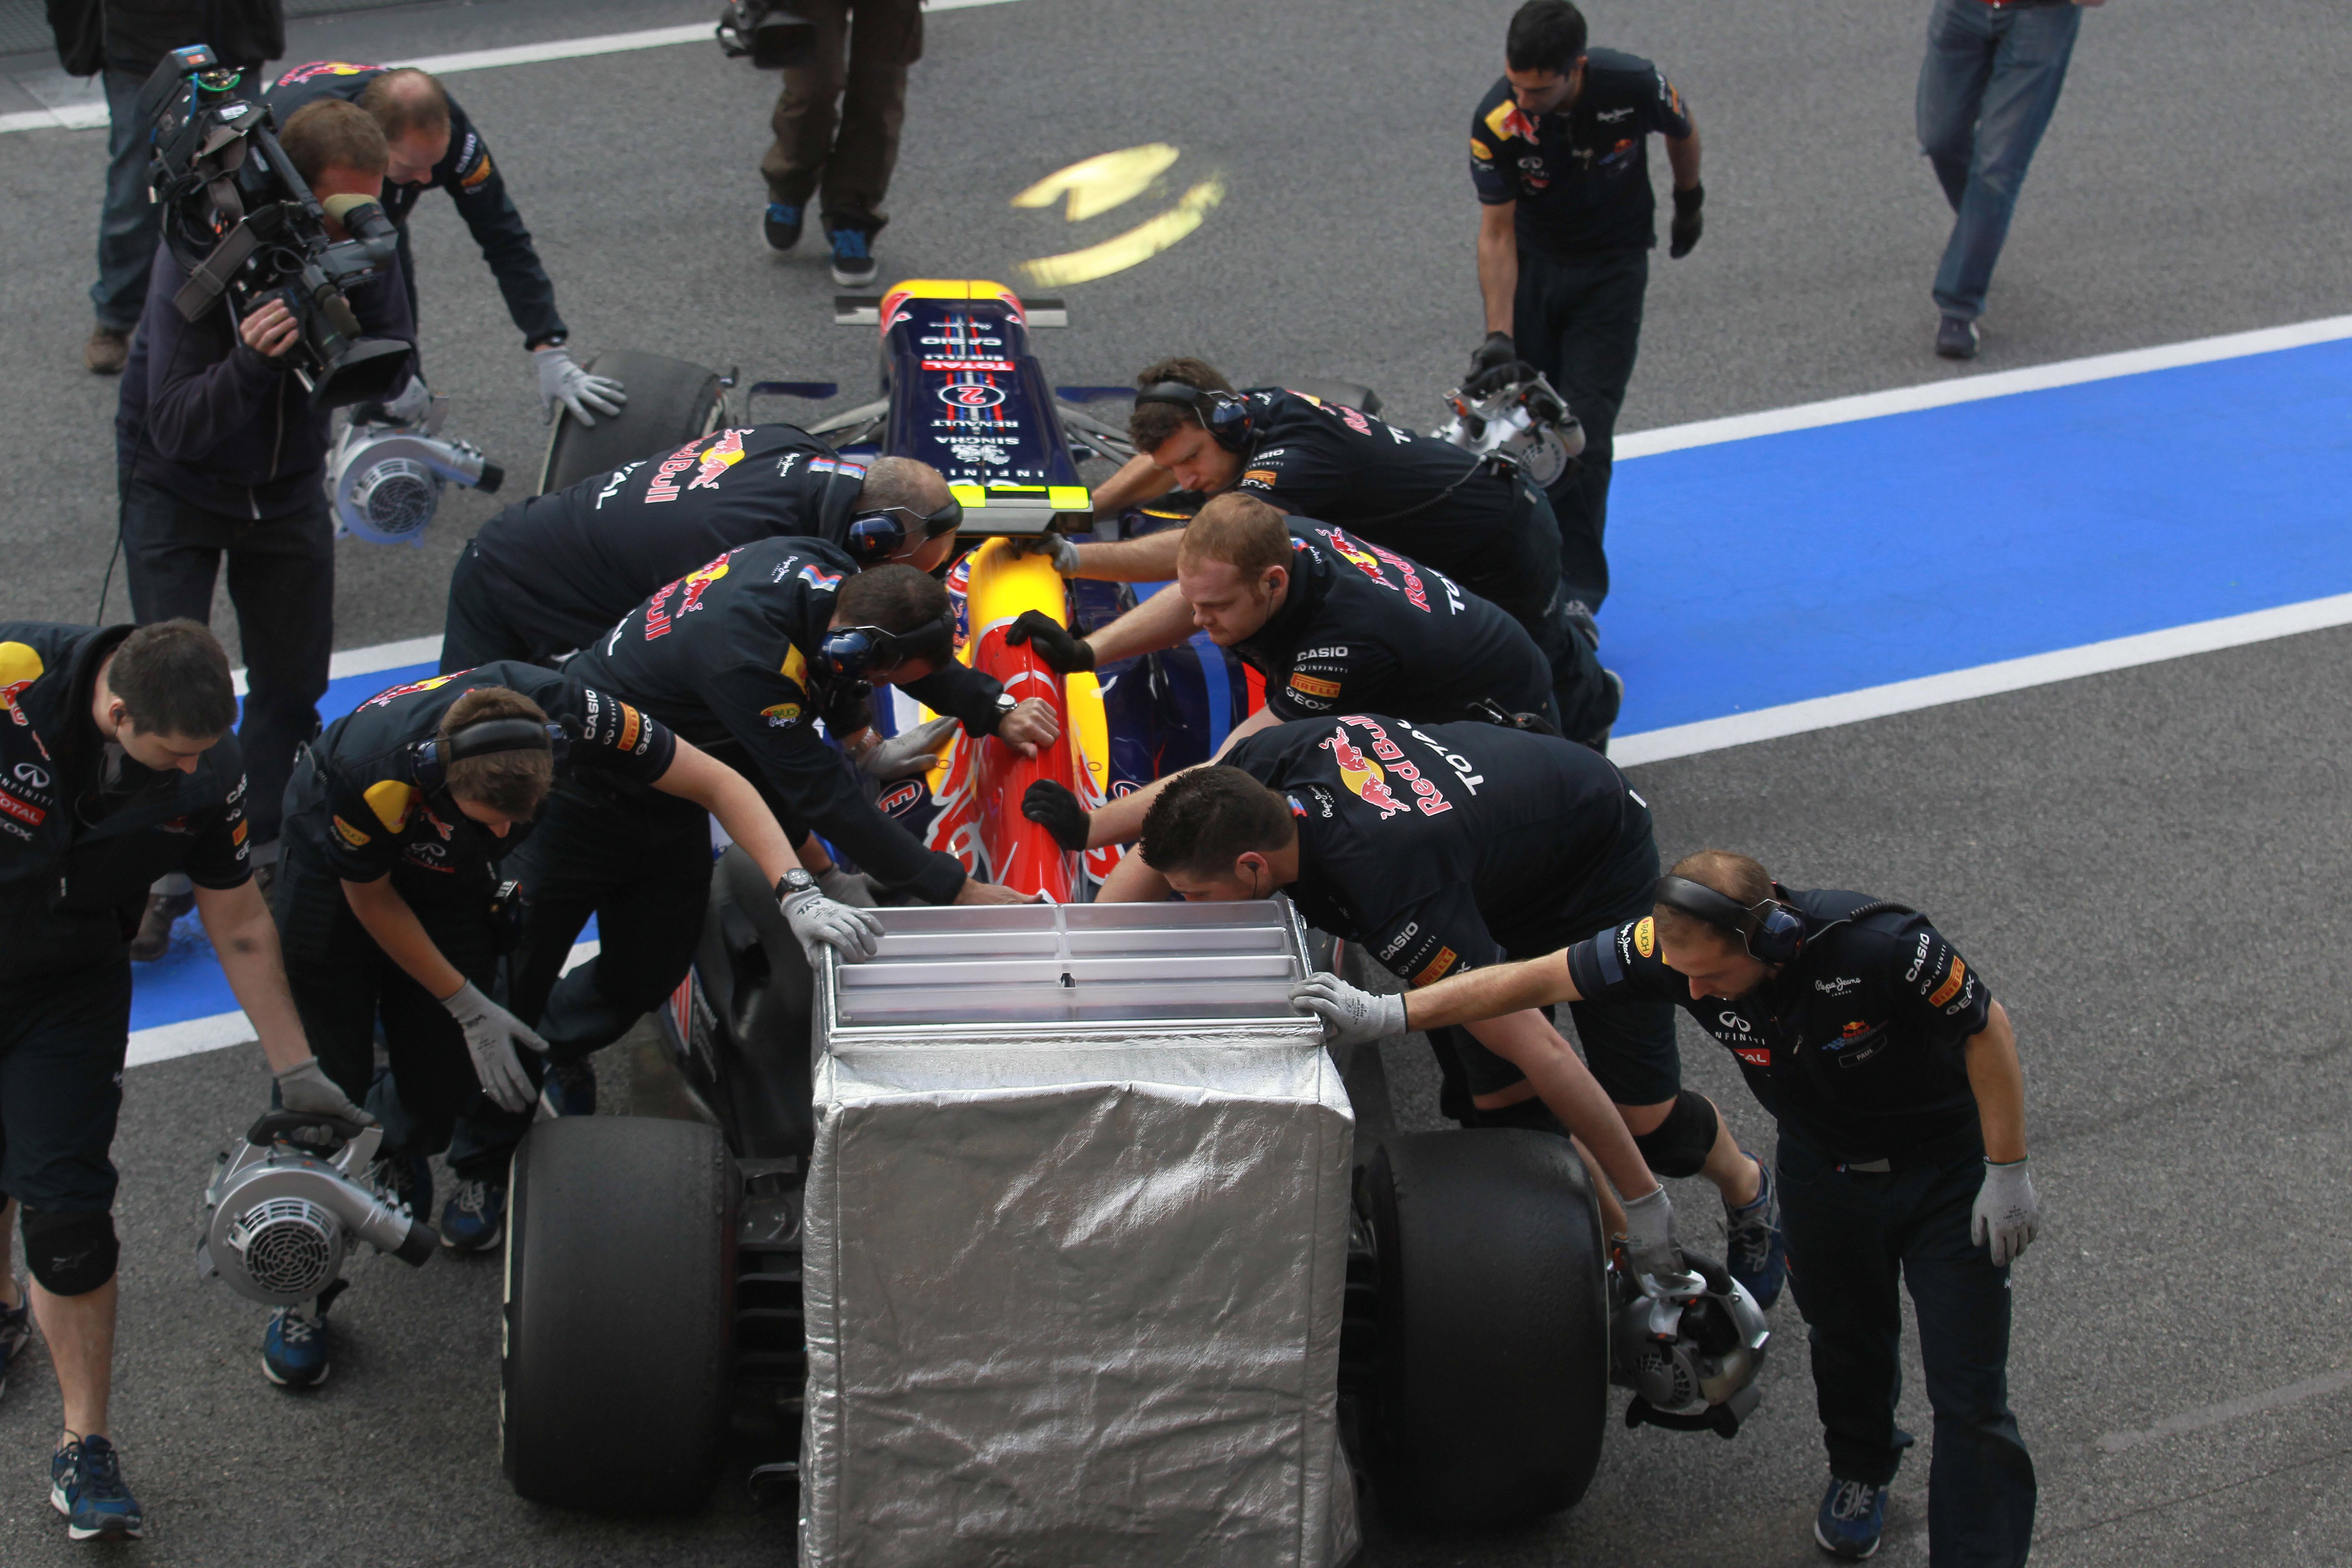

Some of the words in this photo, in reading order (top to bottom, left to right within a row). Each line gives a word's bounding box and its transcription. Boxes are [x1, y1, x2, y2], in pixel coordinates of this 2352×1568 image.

[920, 336, 1002, 345] CASIO
[924, 362, 1014, 370] TOTAL
[957, 387, 986, 404] 2
[931, 420, 1019, 428] RENAULT
[934, 436, 1020, 445] SINGHA
[1253, 448, 1285, 461] SIO
[935, 469, 1044, 478] INFINI
[1241, 479, 1273, 490] EOX
[1297, 646, 1348, 662] CASIO
[1308, 665, 1348, 674] INFINITI
[1291, 674, 1340, 696] PIRELLI
[1286, 686, 1333, 710] GEOX
[584, 689, 599, 740] CASIO
[635, 711, 653, 755] GEOX
[1397, 719, 1484, 796] TOTAL
[0, 773, 53, 807] NFINITI
[1380, 922, 1419, 961] CASIO
[1641, 923, 1651, 952] RAUCH
[1408, 935, 1436, 967] INFINITI
[1905, 933, 1930, 982] CASIO
[1932, 944, 1947, 980] INFINITI
[1815, 980, 1837, 993] Pepe
[1836, 977, 1862, 991] Jeans
[1930, 957, 1964, 1006] PIRELLI
[1947, 975, 1975, 1015] GEOX
[1715, 1031, 1765, 1045] NFINITI
[1856, 1048, 1874, 1061] PAUL
